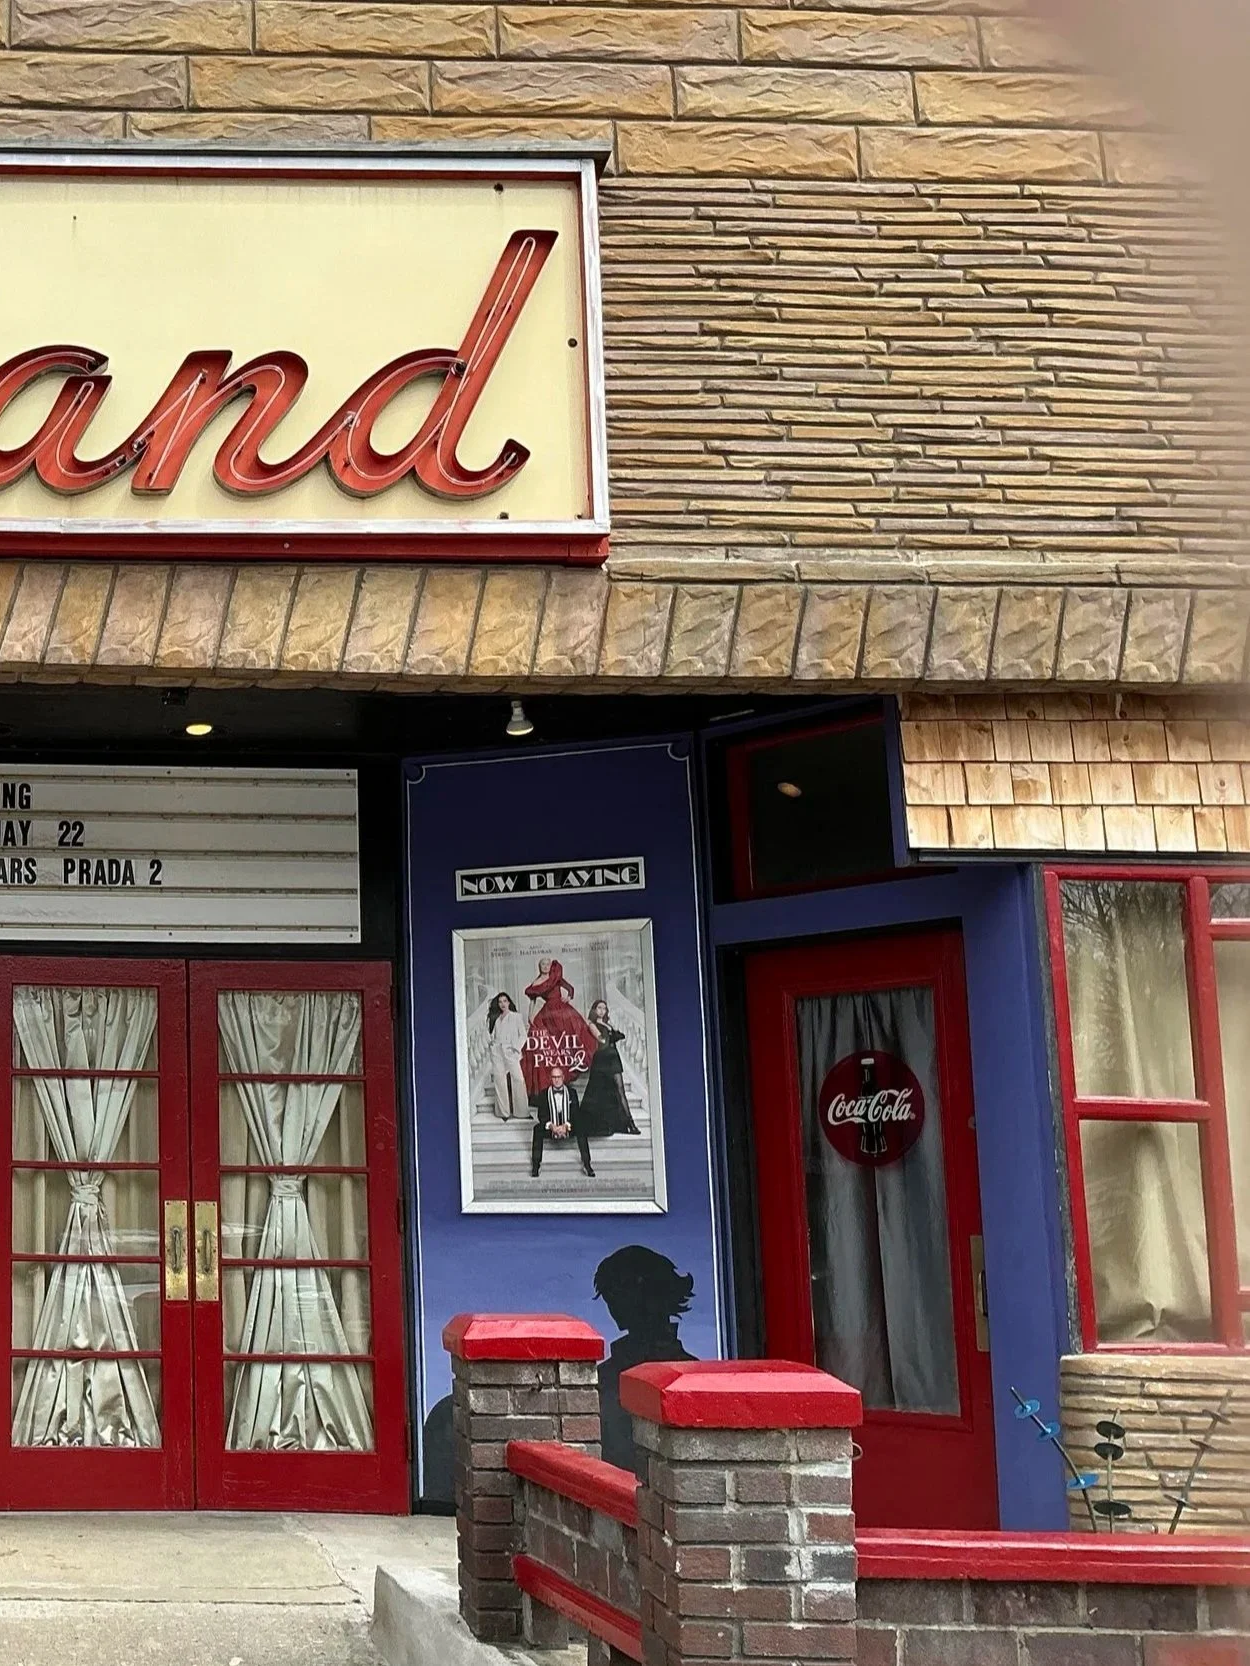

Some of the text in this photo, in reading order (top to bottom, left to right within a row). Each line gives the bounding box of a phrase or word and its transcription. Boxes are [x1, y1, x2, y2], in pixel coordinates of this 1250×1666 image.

[57, 820, 85, 847] 22
[63, 858, 136, 886] PRADA
[149, 859, 163, 886] 2
[462, 865, 639, 895] NOW PLAYING
[525, 1030, 585, 1051] DEVIL
[532, 1029, 548, 1037] THE
[542, 1048, 571, 1057] WEARS
